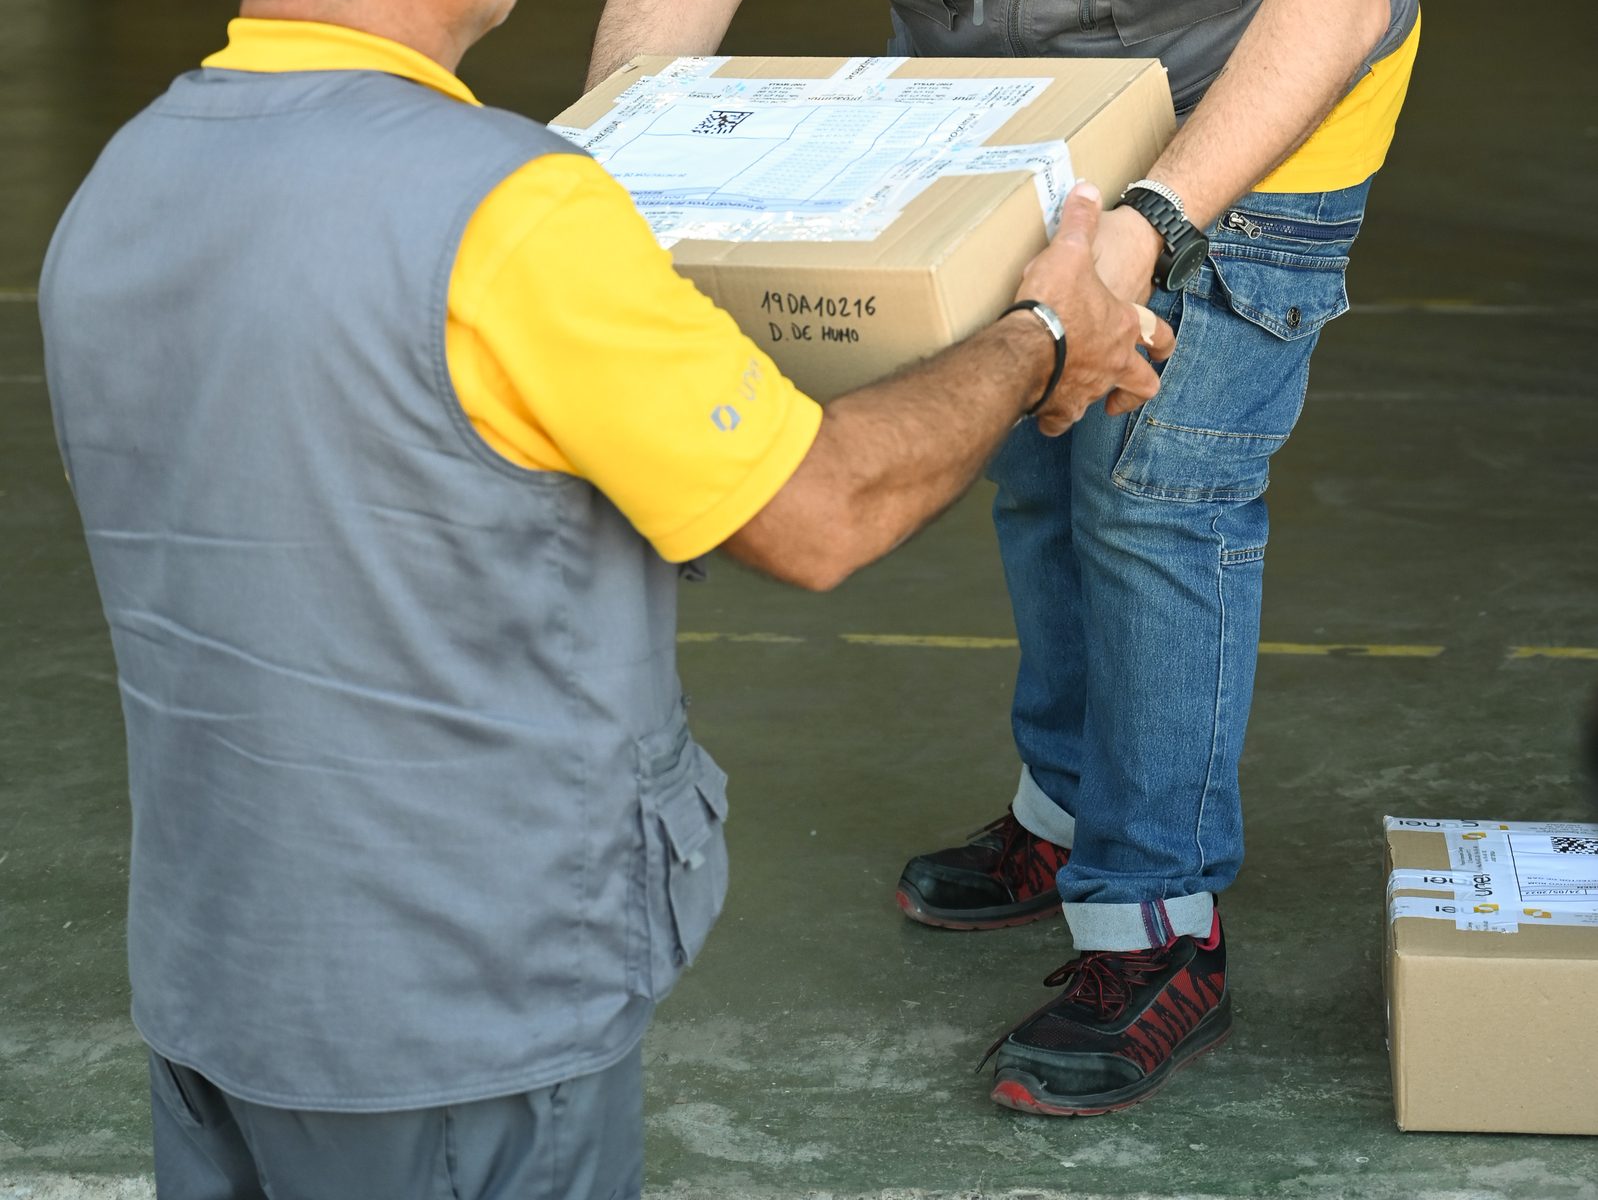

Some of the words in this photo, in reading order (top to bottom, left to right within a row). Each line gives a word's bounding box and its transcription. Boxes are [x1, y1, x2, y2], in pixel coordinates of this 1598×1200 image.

[761, 290, 876, 319] 19DA10216
[791, 322, 812, 341] DE
[821, 325, 860, 344] HUMO
